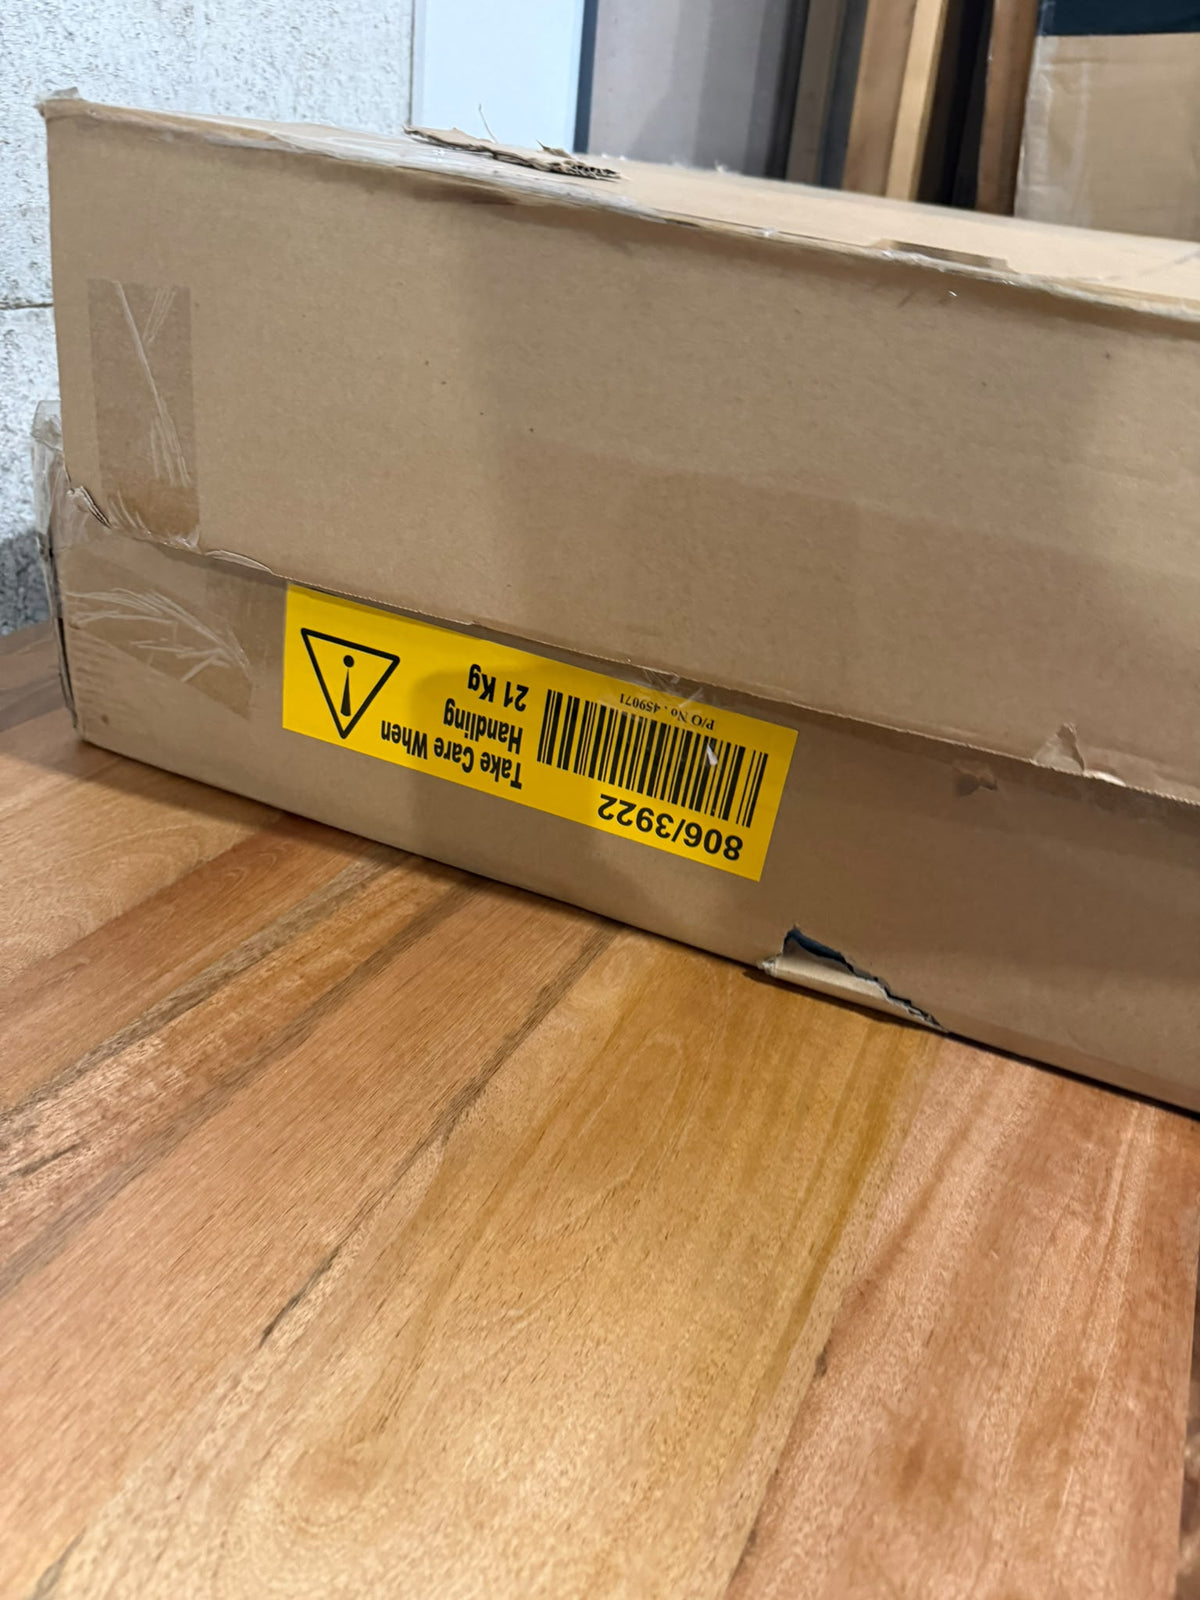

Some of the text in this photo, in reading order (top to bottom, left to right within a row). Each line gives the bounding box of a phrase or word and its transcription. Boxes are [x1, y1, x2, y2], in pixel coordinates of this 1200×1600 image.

[467, 664, 529, 712] 21 Kg
[619, 693, 661, 714] 459071
[443, 698, 523, 755] Handling
[691, 714, 715, 730] P/O
[381, 720, 522, 790] Take Care When
[597, 794, 743, 861] 806/3922
